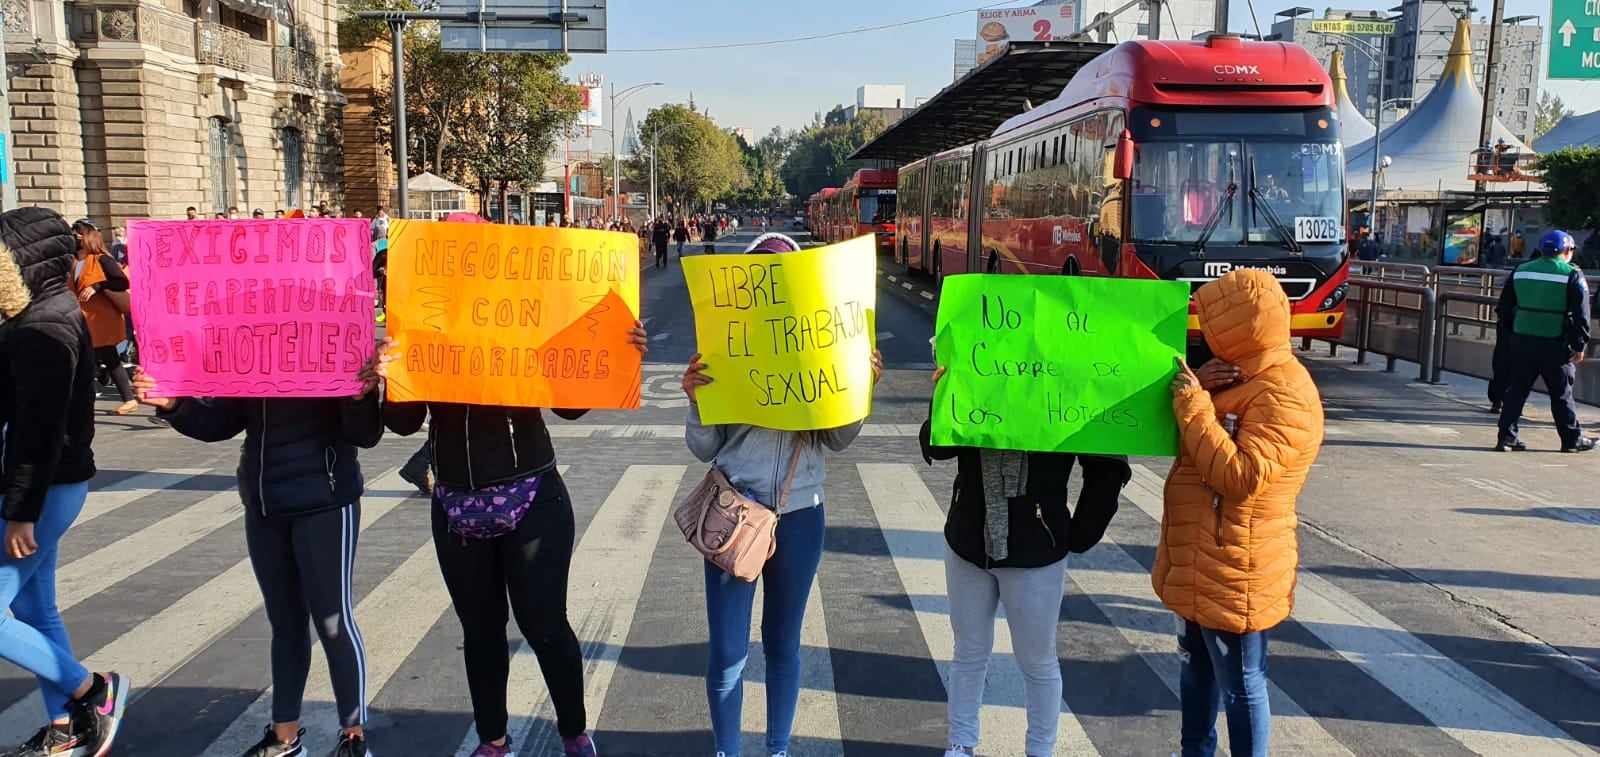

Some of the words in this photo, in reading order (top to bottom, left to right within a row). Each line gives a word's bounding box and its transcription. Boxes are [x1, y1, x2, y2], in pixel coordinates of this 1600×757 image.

[980, 10, 1003, 19] ELIGE
[1004, 9, 1010, 18] Y
[1011, 8, 1036, 17] ARMA
[1357, 23, 1374, 32] 5705
[1033, 19, 1051, 40] 2
[1214, 64, 1260, 75] CDMX
[1301, 143, 1343, 155] CDMX
[1298, 219, 1337, 239] 1302B
[155, 223, 347, 268] EXIGIMOS
[415, 238, 626, 284] NEGOCIACIÓN
[165, 277, 358, 317] REAPERTURA
[709, 263, 787, 310] LIBRE
[472, 298, 541, 328] CON
[1066, 312, 1096, 334] AL
[727, 321, 756, 358] EL
[765, 300, 864, 356] TRABAJO
[149, 336, 186, 365] DE
[202, 320, 363, 375] HOTELES
[407, 343, 610, 380] AUTORIDADES
[749, 363, 848, 407] SEXUAL
[1092, 362, 1122, 378] DE
